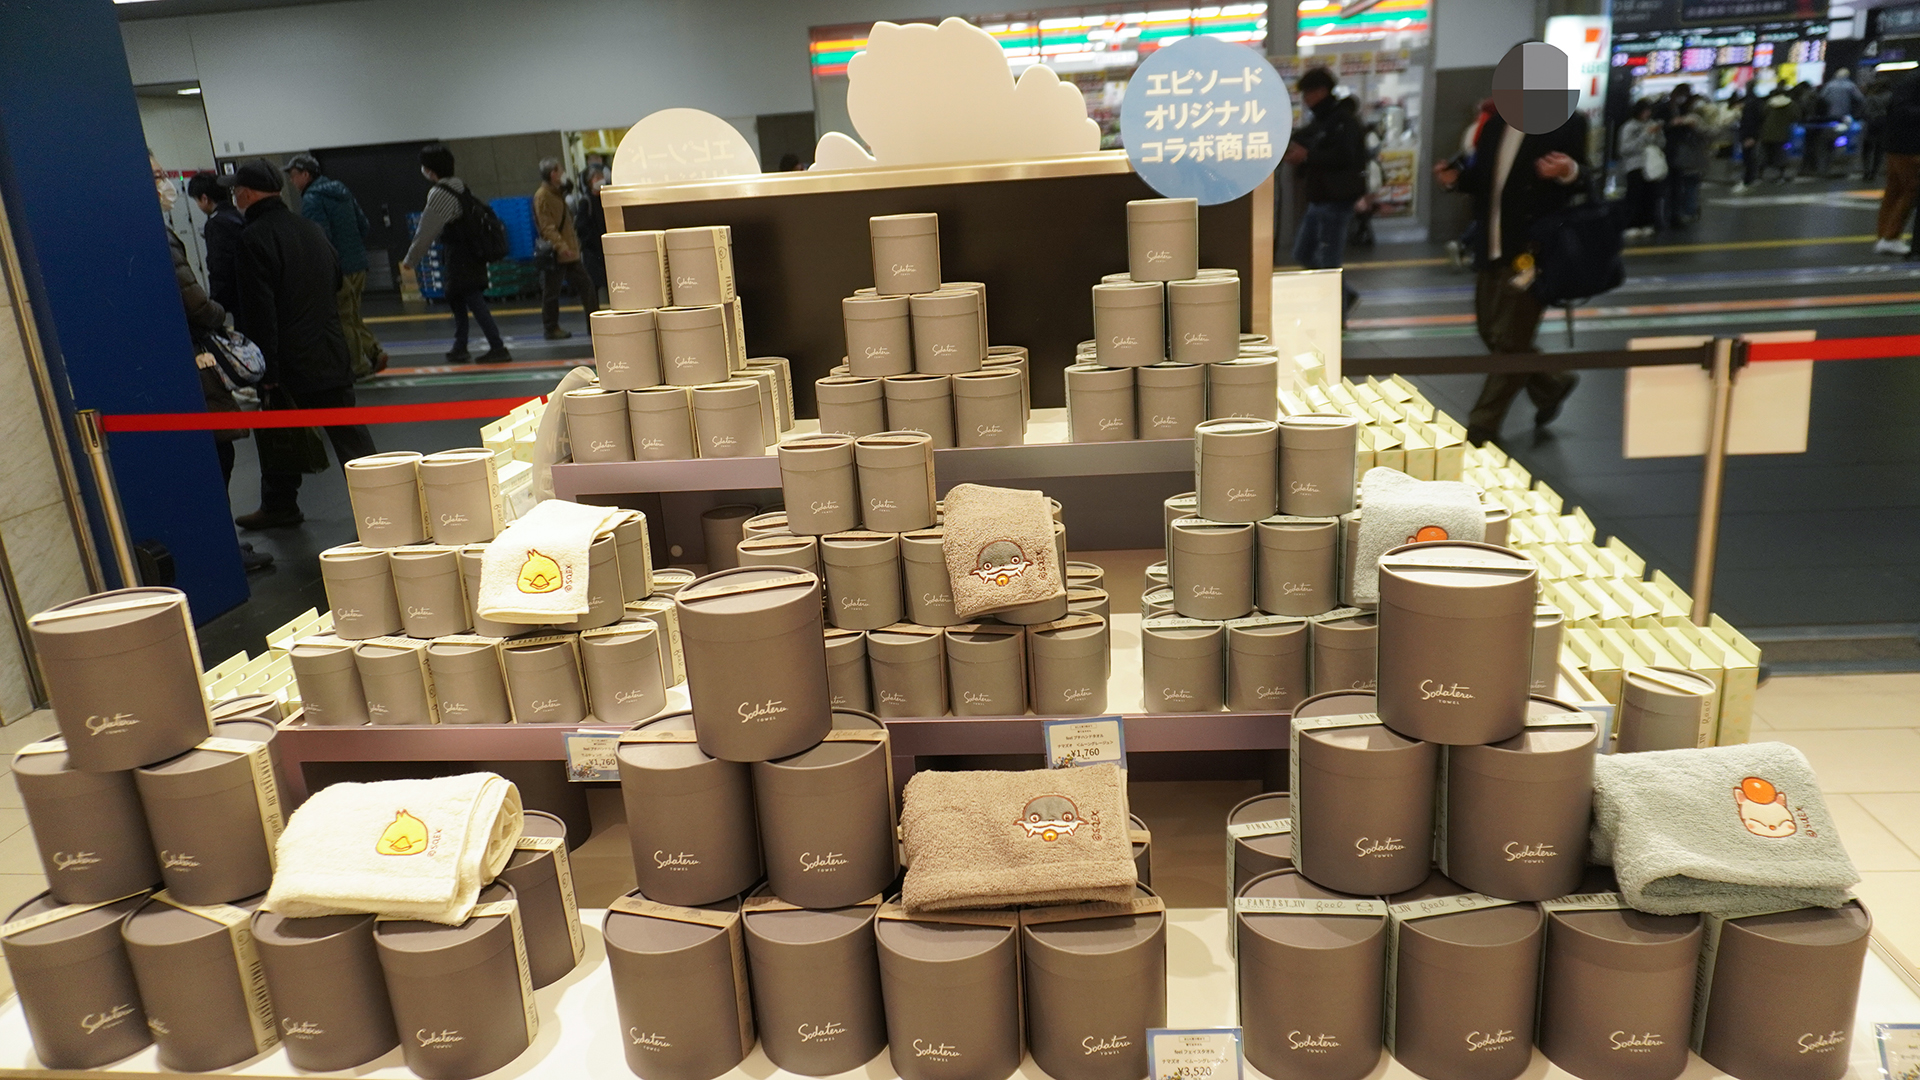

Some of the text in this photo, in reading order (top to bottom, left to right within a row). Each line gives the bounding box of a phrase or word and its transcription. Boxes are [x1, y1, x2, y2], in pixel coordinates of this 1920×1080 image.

[1146, 67, 1262, 96] エピソード
[1144, 99, 1267, 131] オリジナル
[1141, 131, 1273, 164] コラボ商品
[1420, 679, 1476, 700] Sodateru
[737, 699, 789, 724] Sodateru
[1071, 748, 1100, 758] ¥1,760
[1356, 836, 1406, 858] Sodateru
[1504, 842, 1558, 862] Sodateru
[653, 850, 701, 869] Sodateru
[799, 852, 850, 872] Sodateru
[1247, 899, 1289, 908] FANTASY
[1293, 900, 1305, 908] XIV
[416, 1028, 464, 1048] Sodateru
[630, 1027, 672, 1047] Sodateru
[798, 1022, 848, 1043] Sodateru
[1287, 1030, 1341, 1050] Sodateru
[1465, 1030, 1515, 1052] Sodateru
[1609, 1030, 1664, 1051] Sodateru
[1798, 1031, 1846, 1053] Sodateru
[913, 1038, 962, 1057] Sodateru
[1081, 1035, 1132, 1055] Sodateru
[1178, 1066, 1212, 1078] ¥3,520
